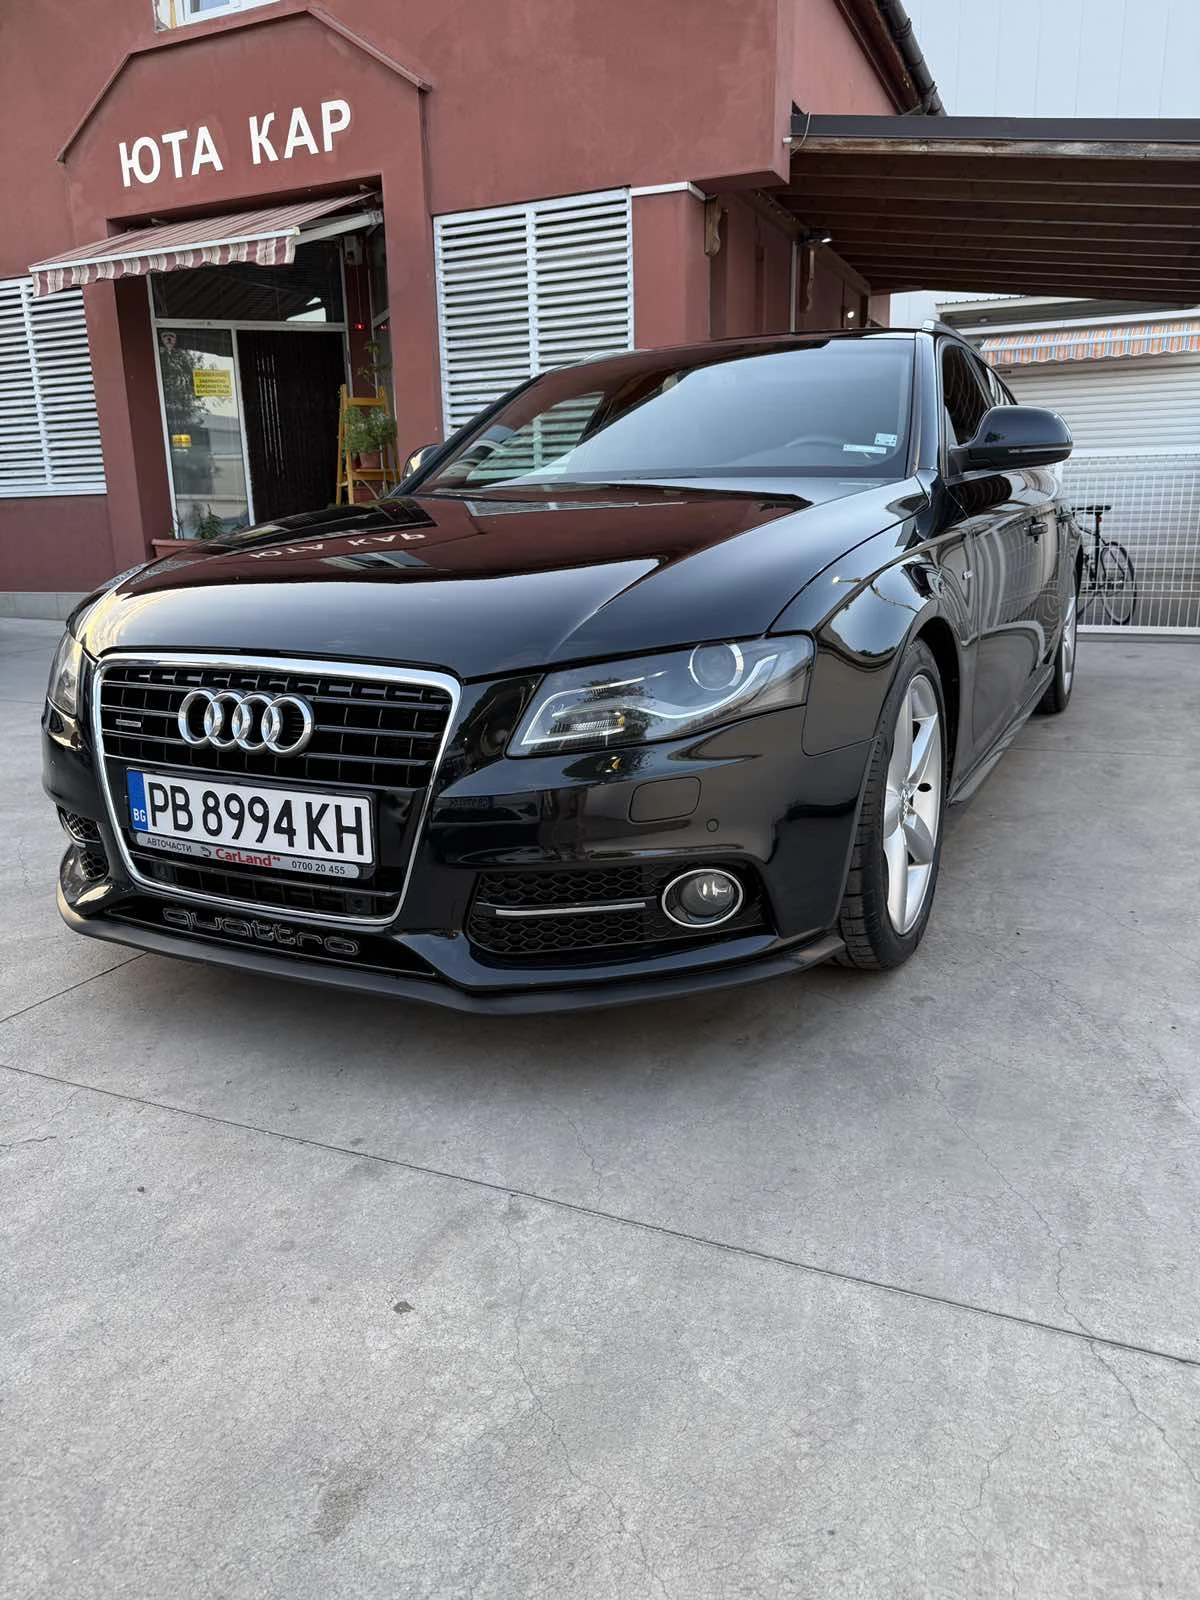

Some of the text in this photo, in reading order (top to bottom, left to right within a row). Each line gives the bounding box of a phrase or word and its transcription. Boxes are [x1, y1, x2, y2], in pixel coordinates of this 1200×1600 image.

[119, 99, 351, 187] ЮТА КАР
[133, 808, 147, 822] BG
[148, 781, 365, 856] PB 8994 KH
[147, 837, 192, 853] АВТОЧАСТИ
[215, 848, 273, 867] CarLand
[291, 860, 346, 875] 0700 20 455
[163, 907, 359, 956] quattro
